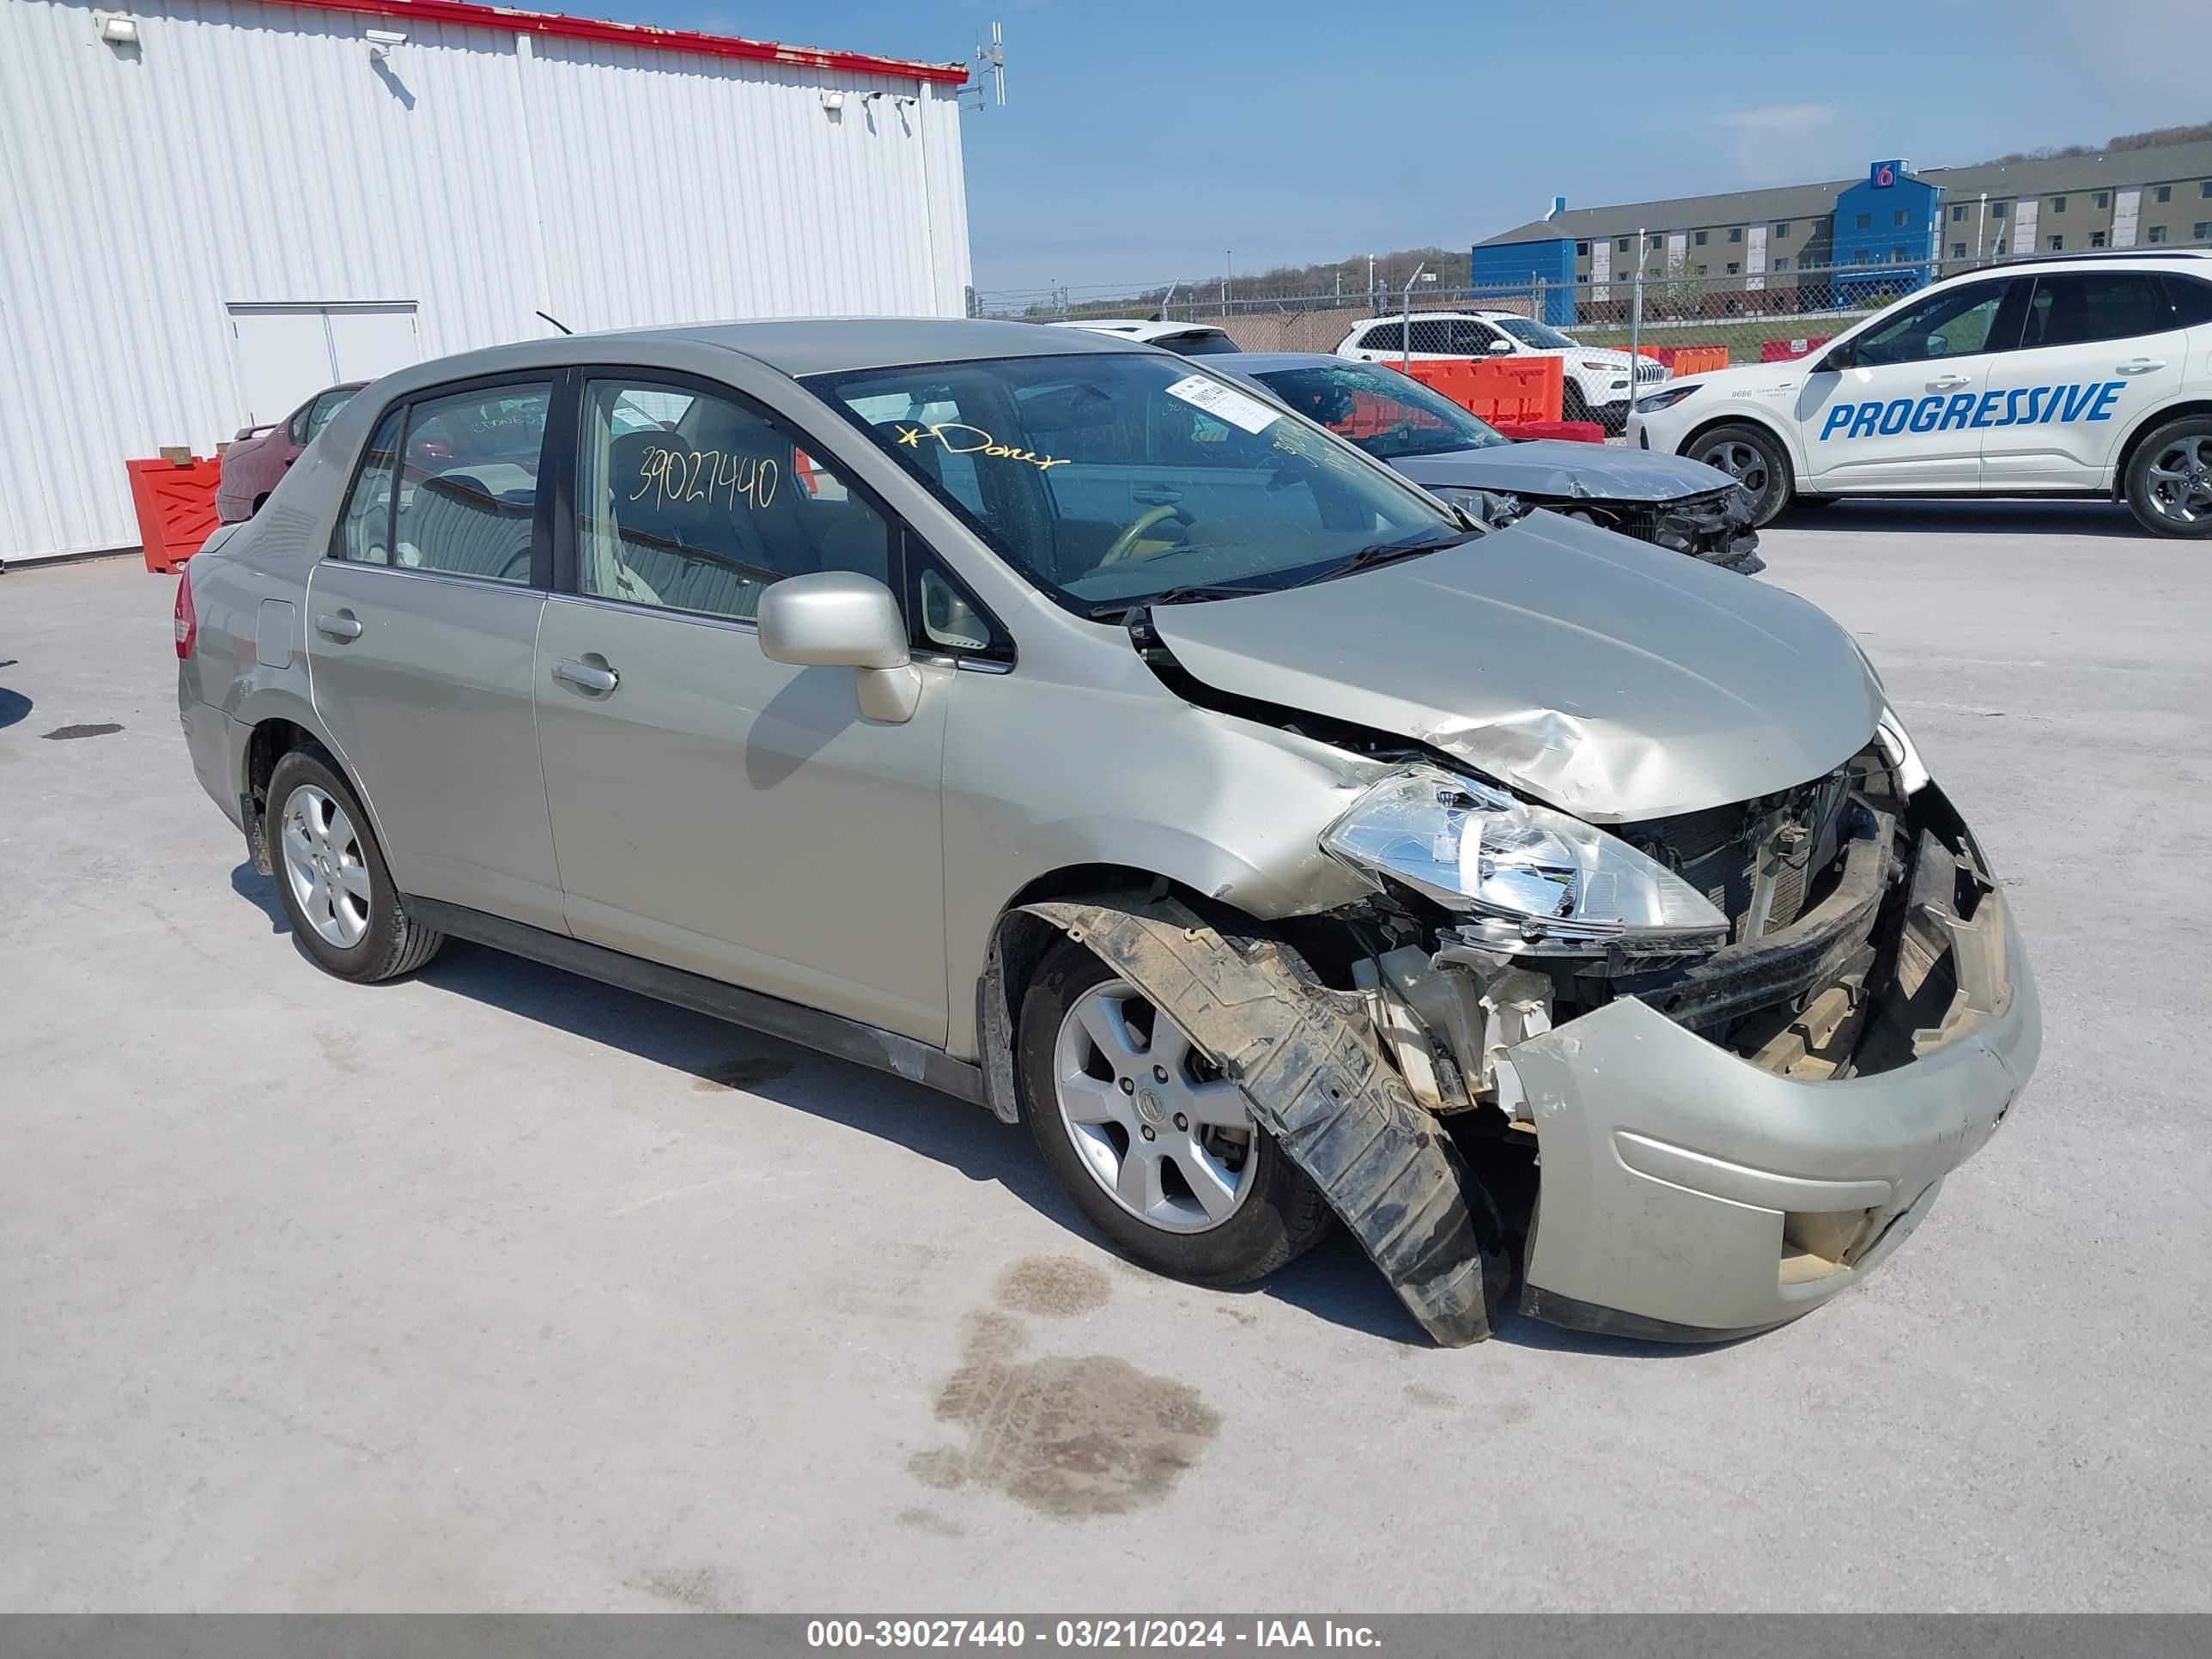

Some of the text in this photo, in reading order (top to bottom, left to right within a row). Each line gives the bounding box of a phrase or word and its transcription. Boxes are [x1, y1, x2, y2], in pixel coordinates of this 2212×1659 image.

[1877, 164, 1893, 186] 6
[1731, 390, 1753, 398] 9686
[1819, 380, 2128, 441] PROGRESSIVE
[629, 446, 778, 512] 39027440
